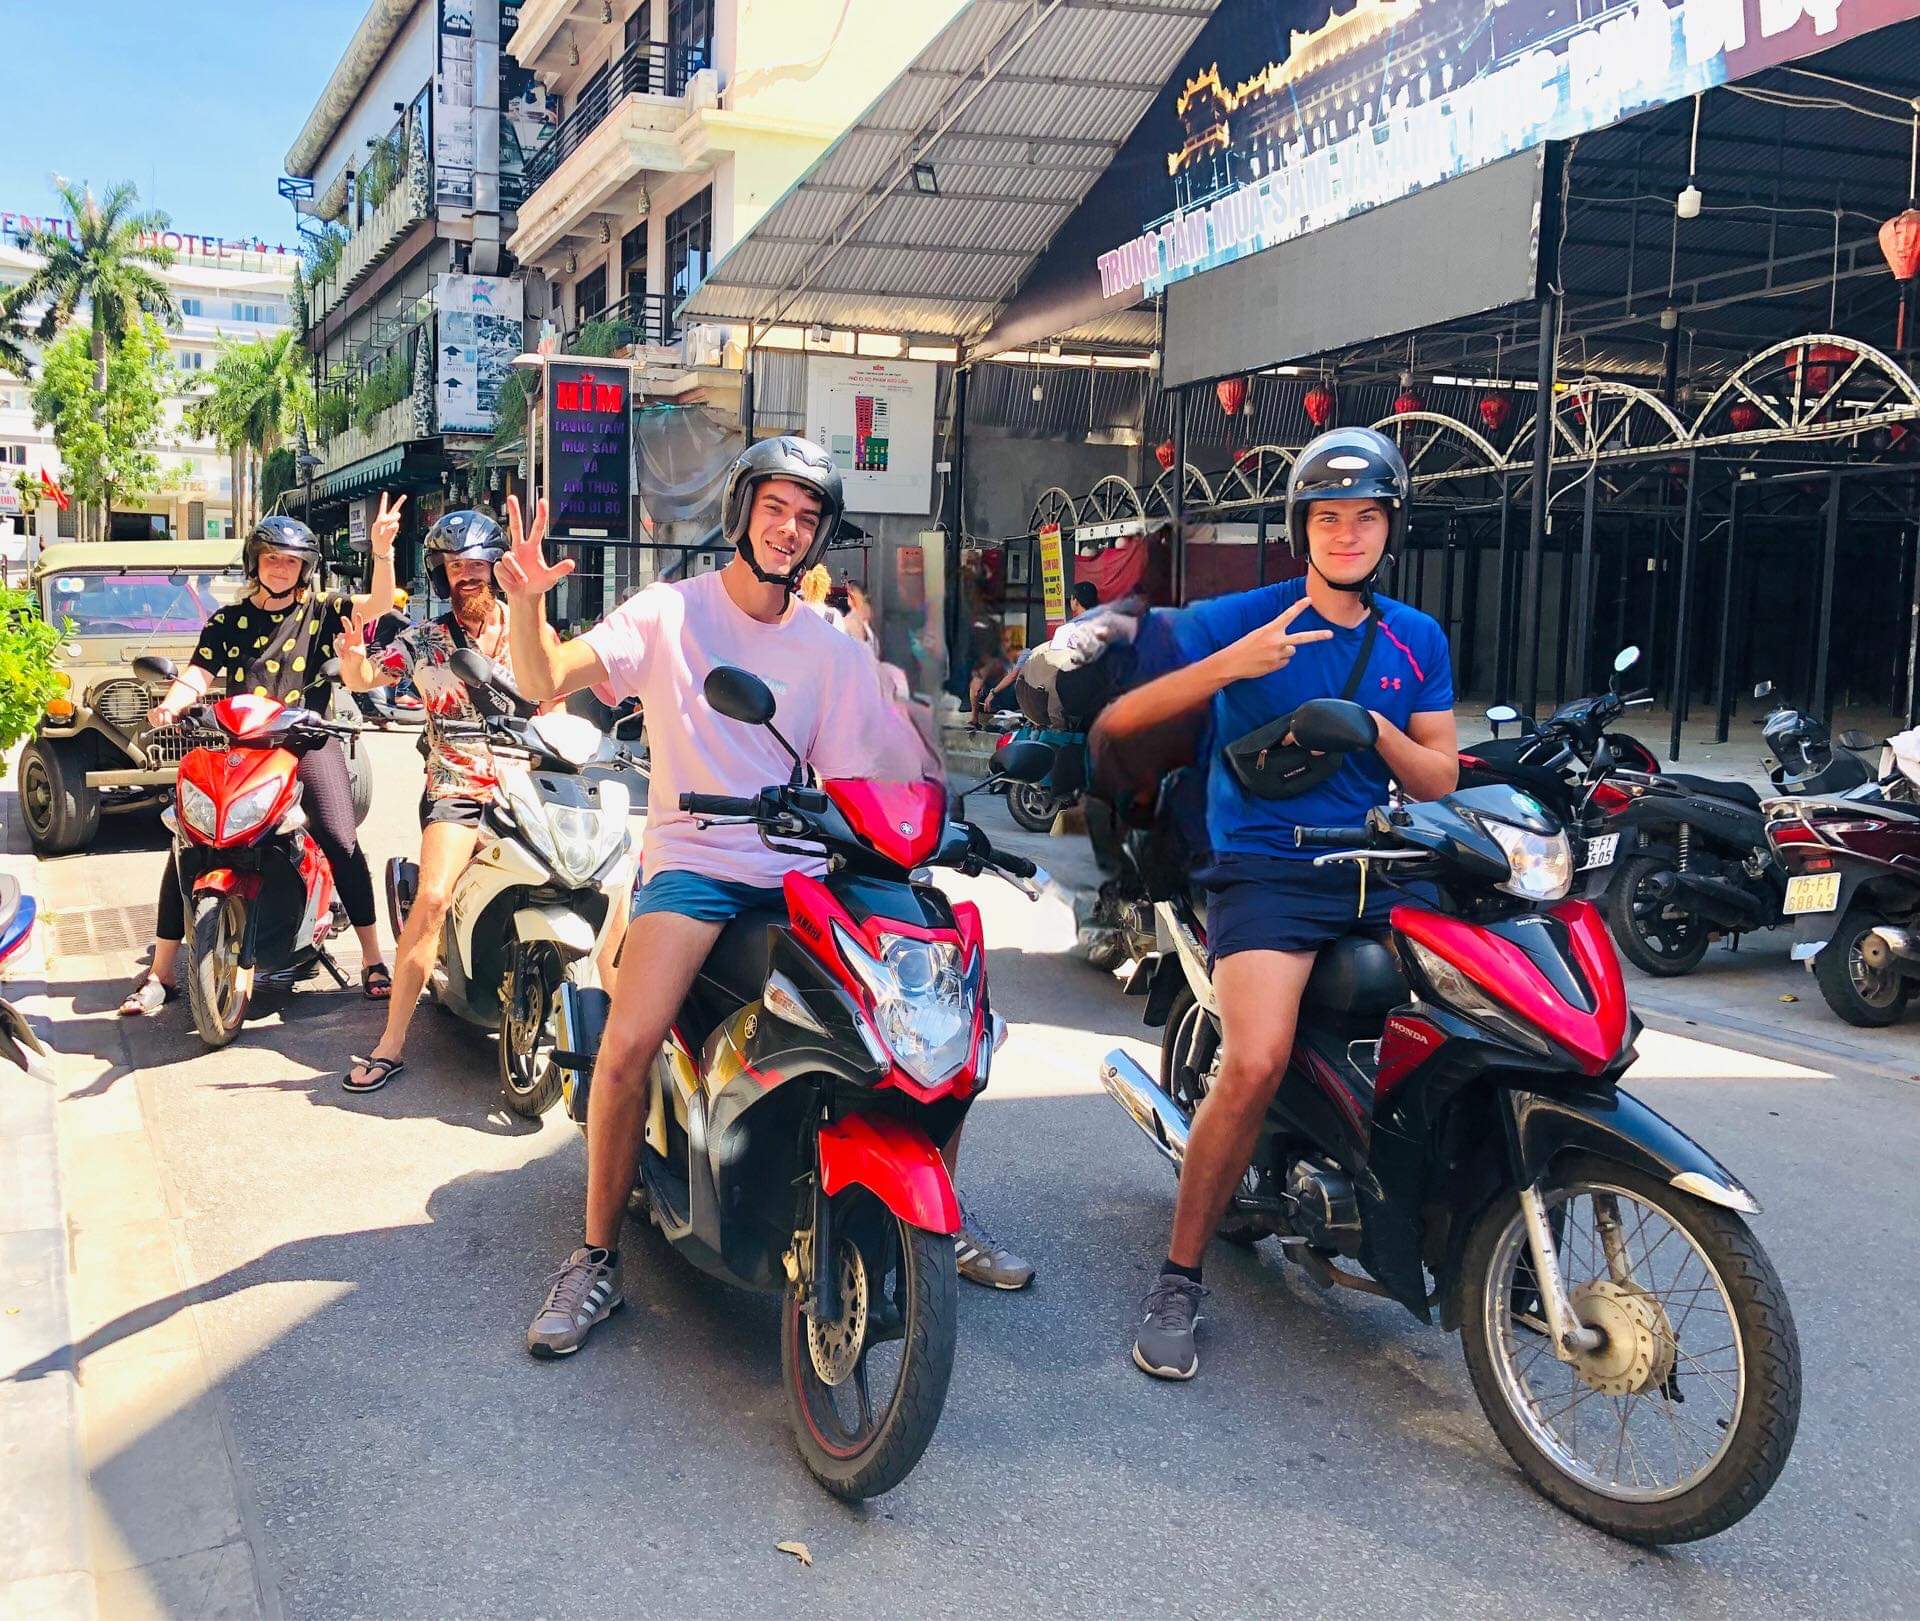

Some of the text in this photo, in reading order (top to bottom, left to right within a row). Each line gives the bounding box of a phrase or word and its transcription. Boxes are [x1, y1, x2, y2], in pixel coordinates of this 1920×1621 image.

[138, 231, 232, 258] HOTEL
[1097, 230, 1160, 299] TRUNG
[1160, 206, 1209, 271] TÂM
[1210, 187, 1266, 250] MUA
[1390, 1020, 1429, 1045] HONDA
